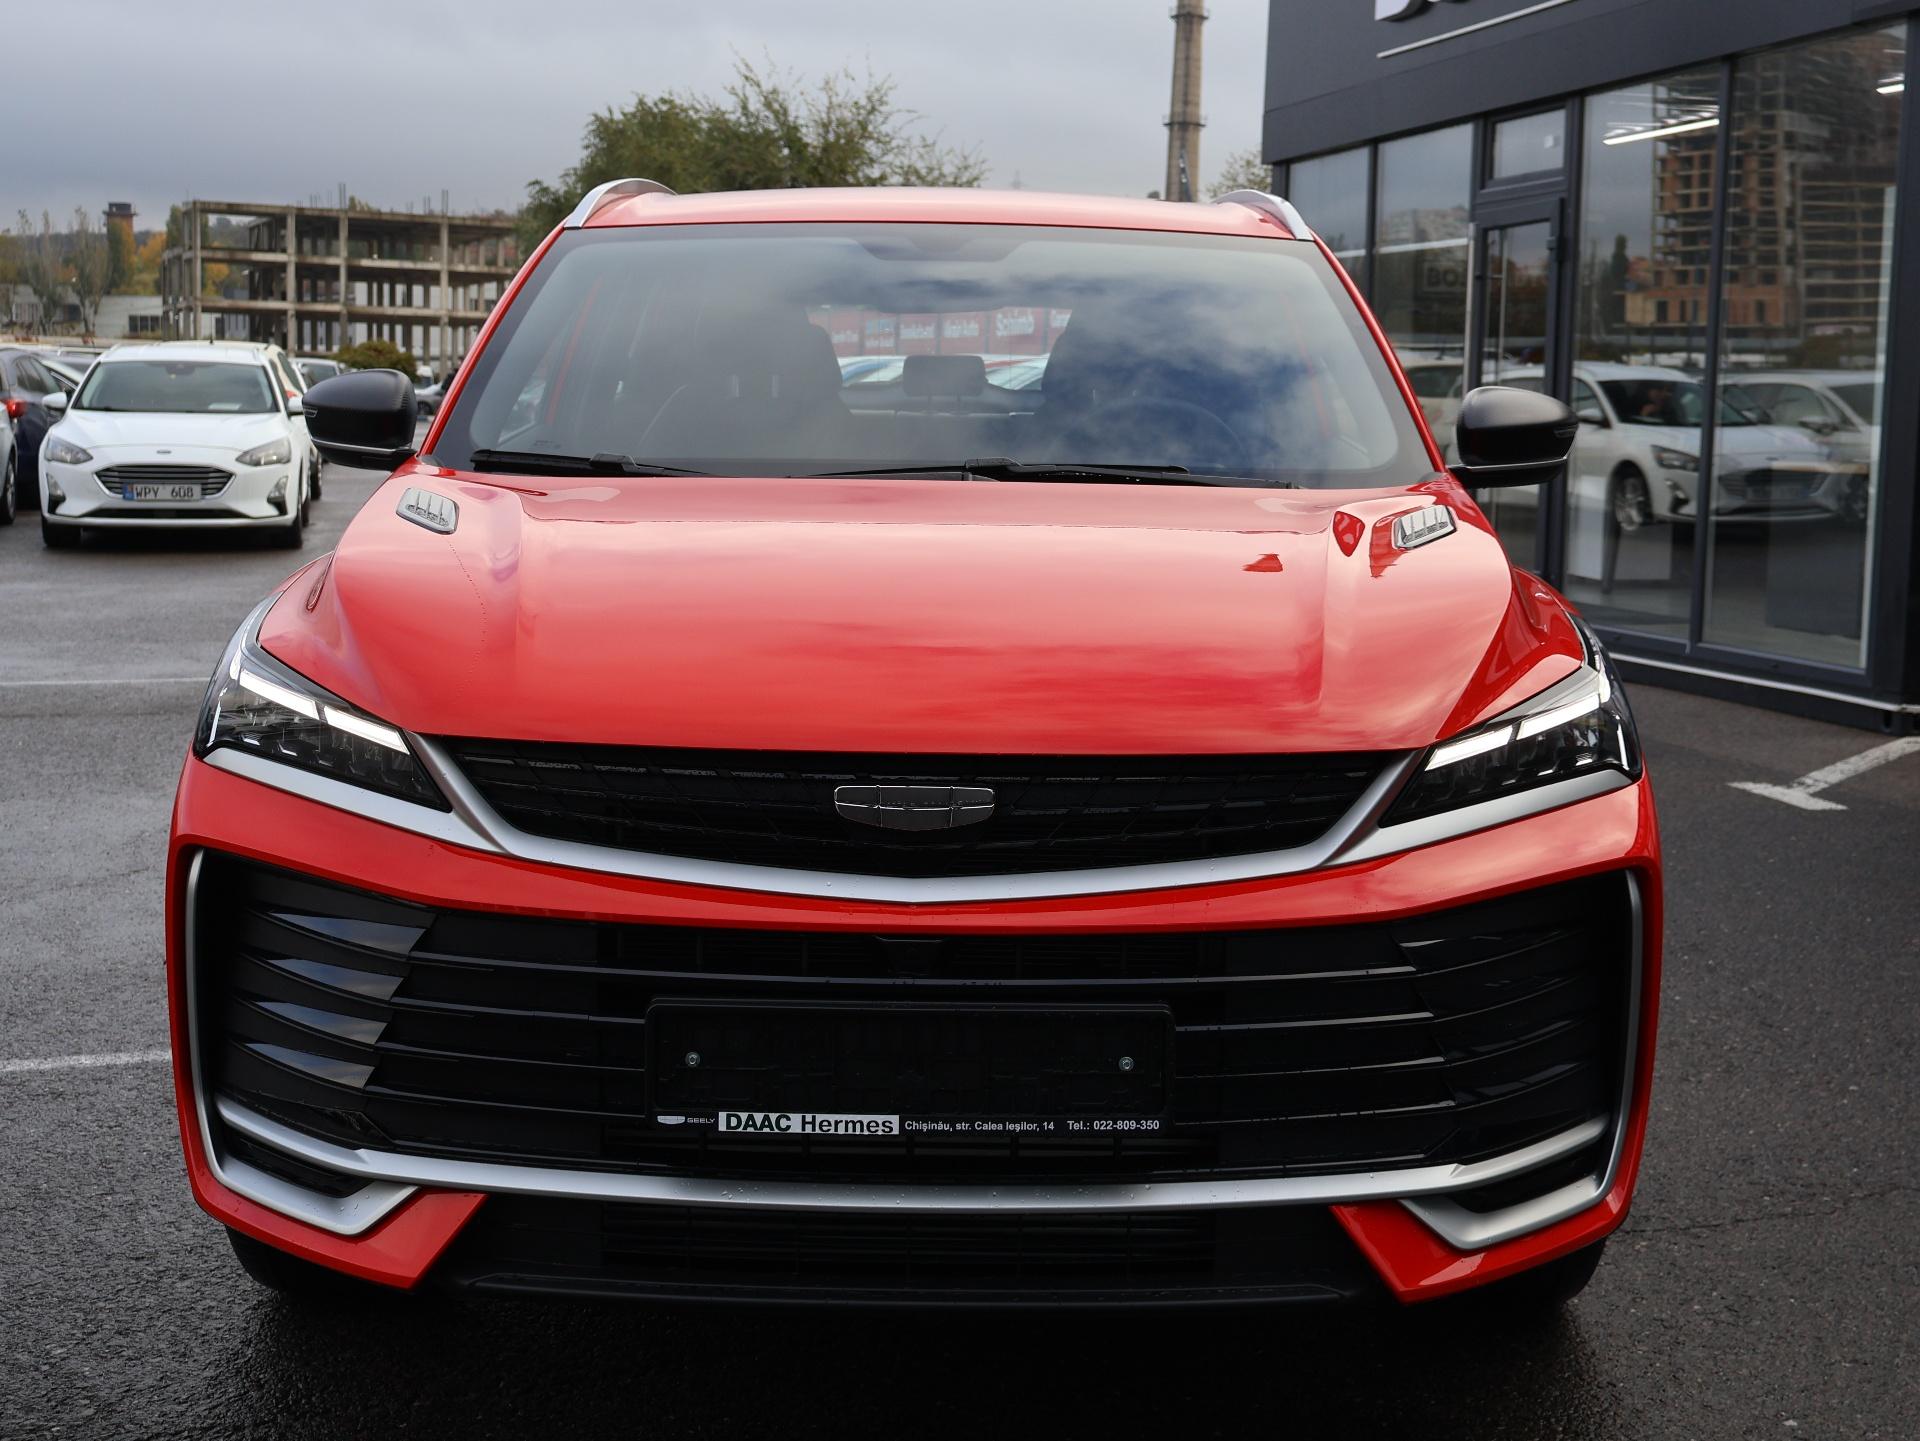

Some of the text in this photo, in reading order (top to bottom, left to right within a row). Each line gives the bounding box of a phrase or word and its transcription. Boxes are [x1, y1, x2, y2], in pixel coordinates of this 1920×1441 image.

[135, 486, 160, 498] WPY
[725, 1113, 894, 1133] DAAC Hermes
[955, 1122, 972, 1130] str.
[974, 1122, 1003, 1130] Calea
[1043, 1122, 1055, 1130] 14
[1066, 1120, 1160, 1130] Tel.: 022-809-350
